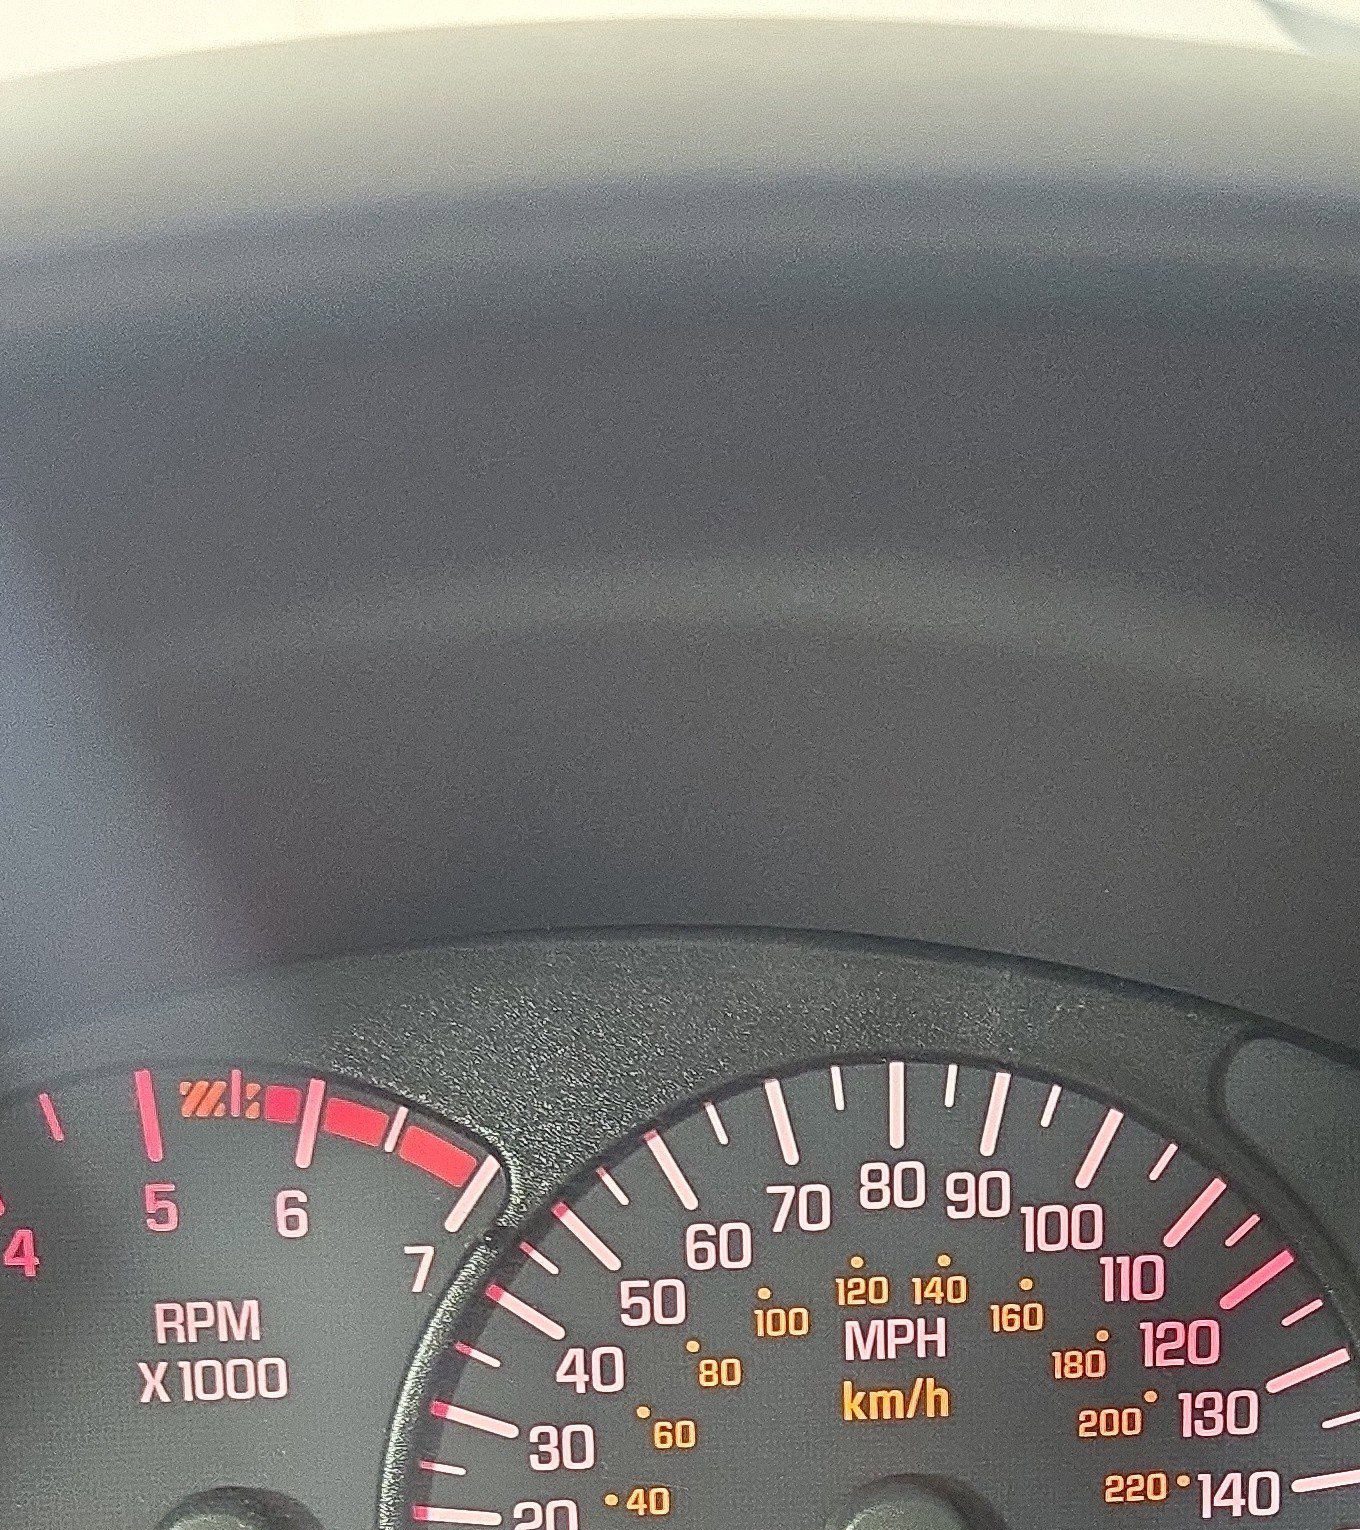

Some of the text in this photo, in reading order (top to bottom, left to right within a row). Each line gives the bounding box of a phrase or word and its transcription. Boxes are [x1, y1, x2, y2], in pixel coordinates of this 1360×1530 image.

[145, 1184, 178, 1231] 5
[860, 1161, 925, 1209] 80
[946, 1171, 1010, 1219] 90
[276, 1190, 307, 1237] 6
[766, 1184, 830, 1232] 70
[1021, 1204, 1102, 1252] 100
[3, 1229, 39, 1276] 4
[404, 1246, 434, 1292] 7
[686, 1223, 751, 1270] 60
[836, 1277, 888, 1305] 120
[912, 1276, 966, 1304] 140
[1100, 1255, 1164, 1301] 110
[155, 1300, 260, 1343] RPM
[621, 1279, 685, 1326] 50
[754, 1308, 808, 1336] 100
[990, 1303, 1043, 1332] 160
[845, 1318, 945, 1360] MPH
[1140, 1320, 1219, 1366] 120
[138, 1358, 287, 1402] X 1000
[556, 1347, 623, 1393] 40
[699, 1359, 741, 1386] 80
[1052, 1350, 1106, 1378] 180
[843, 1378, 948, 1420] km/h
[1179, 1390, 1258, 1437] 130
[654, 1421, 695, 1448] 60
[1079, 1408, 1141, 1437] 200
[530, 1425, 594, 1470] 30
[626, 1488, 669, 1515] 40
[1105, 1473, 1167, 1502] 220
[1197, 1471, 1280, 1518] 140
